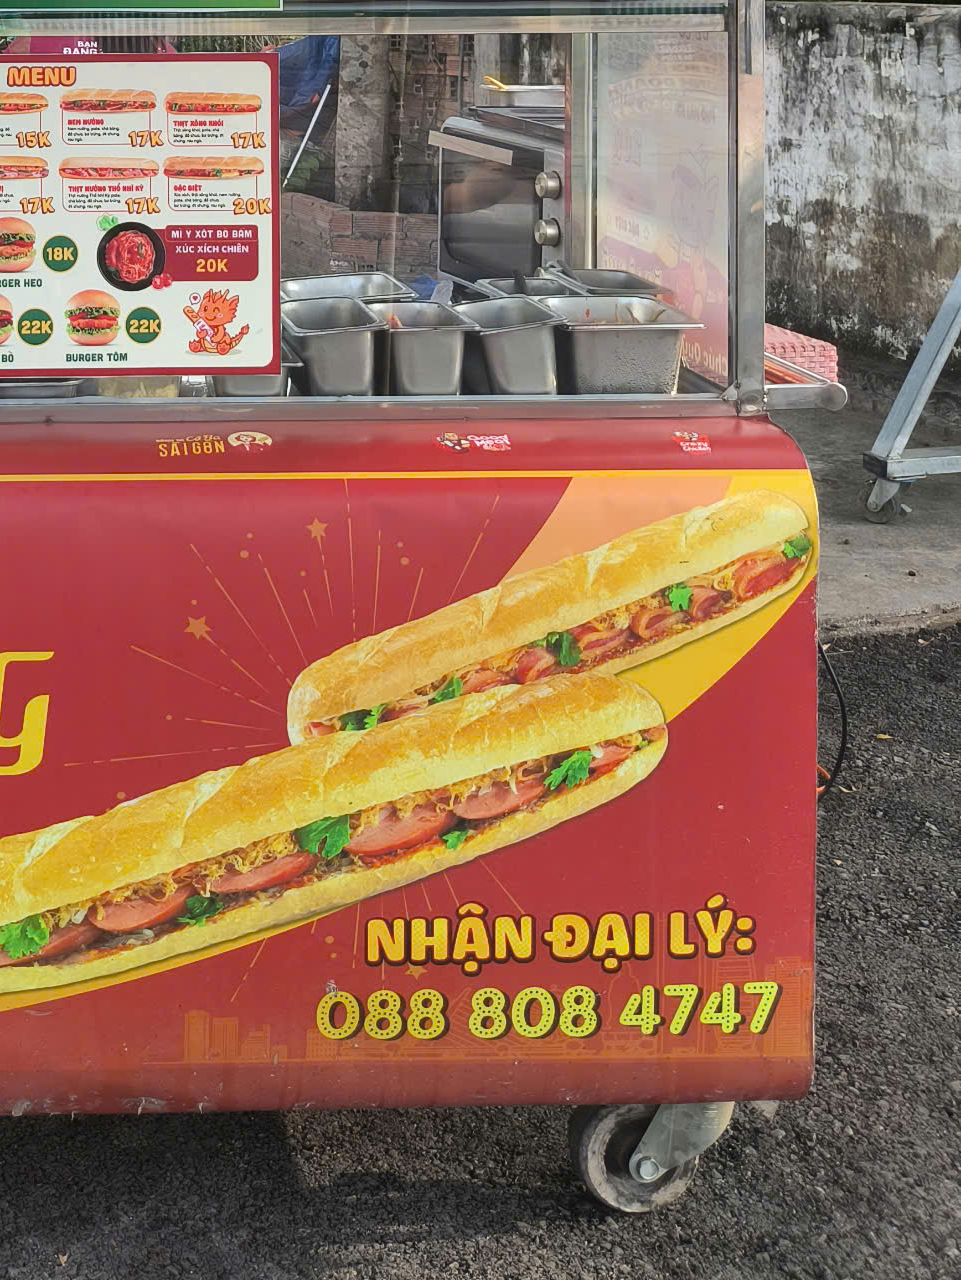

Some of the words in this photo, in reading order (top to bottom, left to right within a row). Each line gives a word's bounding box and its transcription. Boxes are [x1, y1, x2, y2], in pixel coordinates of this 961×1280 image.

[7, 66, 76, 87] MENU
[16, 132, 52, 148] 15K
[128, 130, 164, 147] 17K
[231, 132, 266, 149] 17K
[20, 197, 55, 214] 17K
[125, 198, 161, 214] 17K
[233, 198, 272, 215] 20K
[46, 248, 74, 261] 18K
[176, 244, 194, 253] XÚC
[197, 243, 218, 253] XÍCH
[196, 259, 228, 272] 20K
[24, 279, 42, 287] HEO
[21, 321, 52, 334] 22K
[130, 319, 159, 333] 22K
[2, 351, 14, 363] BÒ
[66, 353, 103, 362] BURGER
[107, 352, 127, 361] TÔM
[366, 903, 534, 975] NHẬN
[543, 912, 653, 972] ĐẠI
[668, 895, 757, 957] LÝ:
[316, 989, 446, 1040] 088
[468, 985, 599, 1038] 808
[619, 982, 782, 1035] 4747
